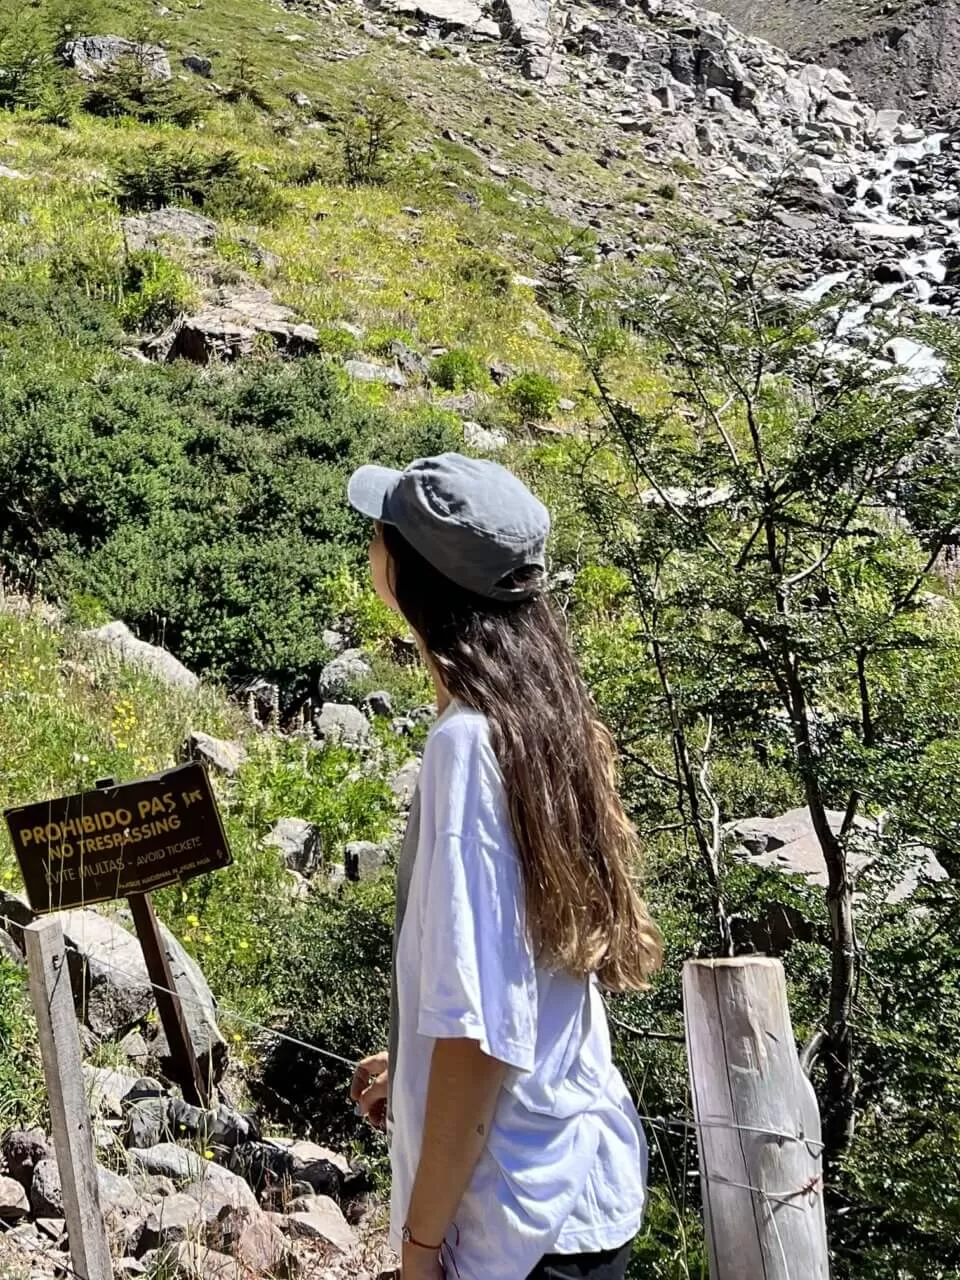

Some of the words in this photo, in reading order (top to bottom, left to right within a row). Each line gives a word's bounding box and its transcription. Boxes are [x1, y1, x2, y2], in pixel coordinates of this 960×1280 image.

[19, 808, 132, 847] PROHIBIDO
[48, 842, 74, 861] NO
[77, 815, 182, 854] TRESPASSING
[79, 858, 125, 880] MULTAS
[136, 848, 166, 866] AVOID
